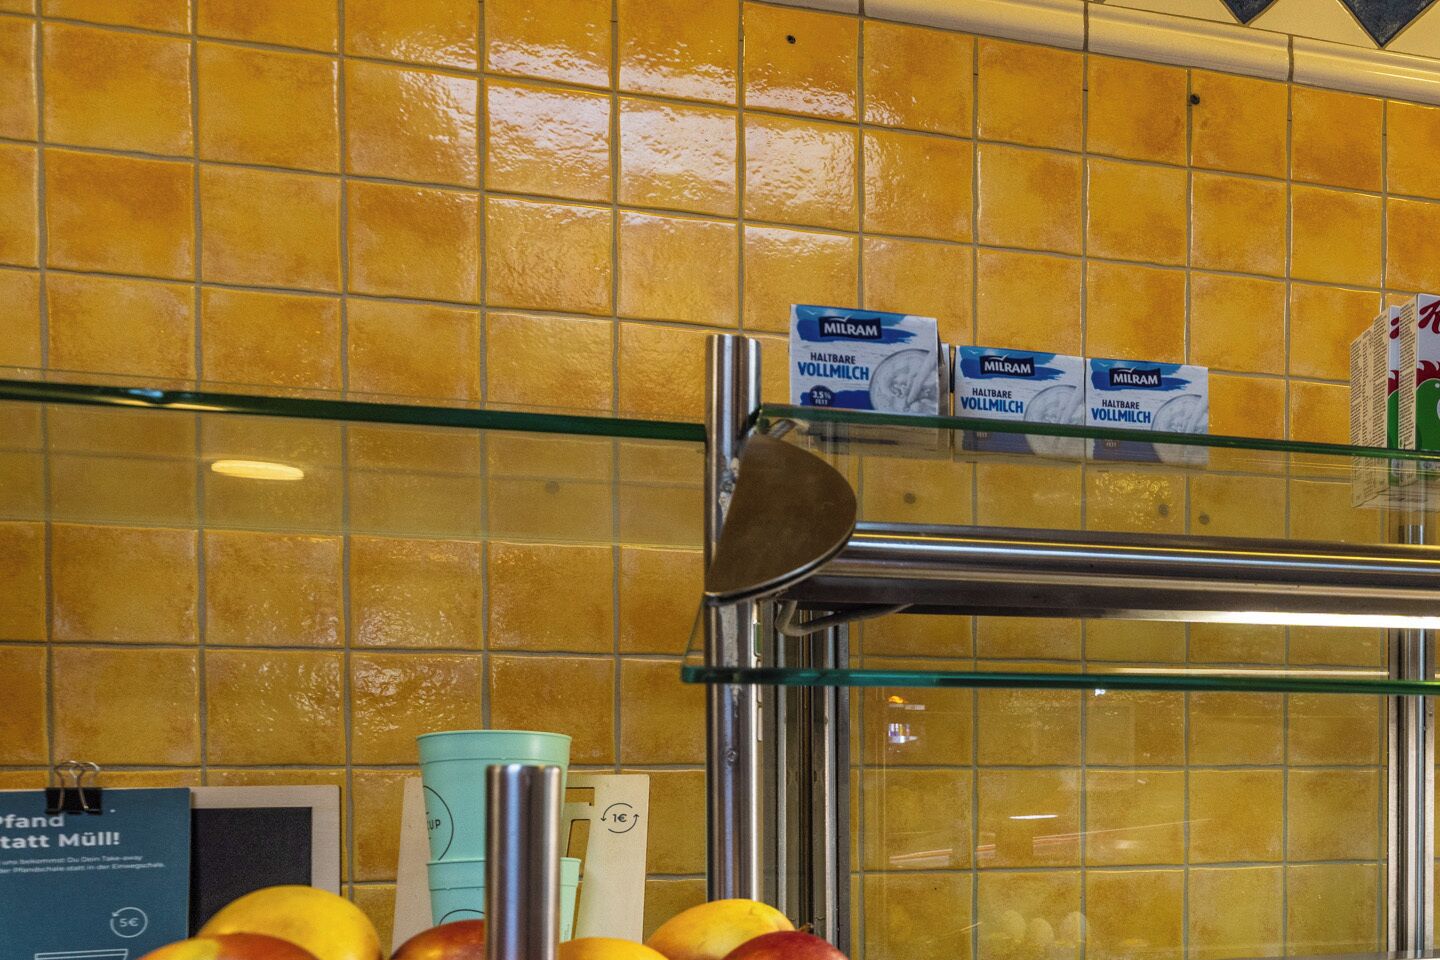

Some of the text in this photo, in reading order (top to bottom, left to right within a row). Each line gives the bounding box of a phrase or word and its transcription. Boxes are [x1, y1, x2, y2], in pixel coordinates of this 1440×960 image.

[823, 322, 878, 337] MILRAM
[810, 352, 856, 364] HALTBARE
[798, 361, 869, 381] VOLLMILCH
[983, 359, 1031, 374] MILRAM
[1113, 373, 1158, 385] MILRAM
[972, 388, 1012, 399] HALTBARE
[960, 397, 1023, 414] VOLLMILCH
[1102, 399, 1140, 410] HALTBARE
[1091, 408, 1151, 424] VOLLMILCH
[0, 813, 65, 829] fand
[612, 813, 628, 823] 1€
[0, 832, 121, 849] tatt Müll!
[119, 917, 140, 928] 5€
